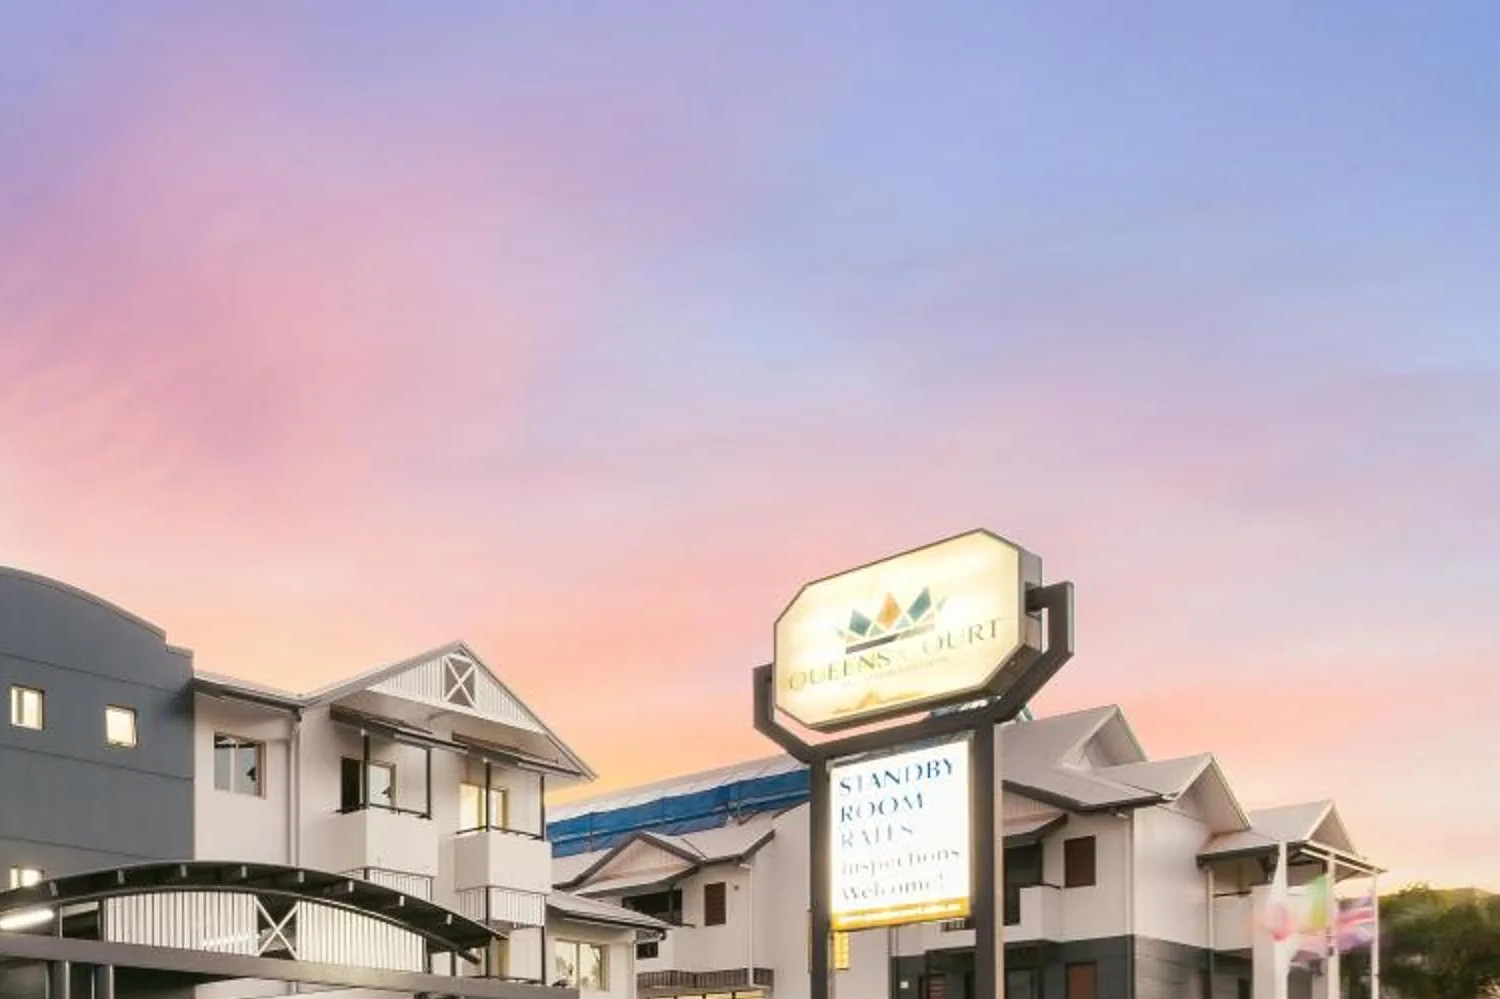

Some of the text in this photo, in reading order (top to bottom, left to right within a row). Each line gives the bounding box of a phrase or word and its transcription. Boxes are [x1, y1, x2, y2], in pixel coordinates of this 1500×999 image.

[788, 652, 891, 691] QUEENS
[897, 616, 1003, 661] OURT
[839, 757, 954, 796] STANDBY
[840, 791, 925, 823] ROOM
